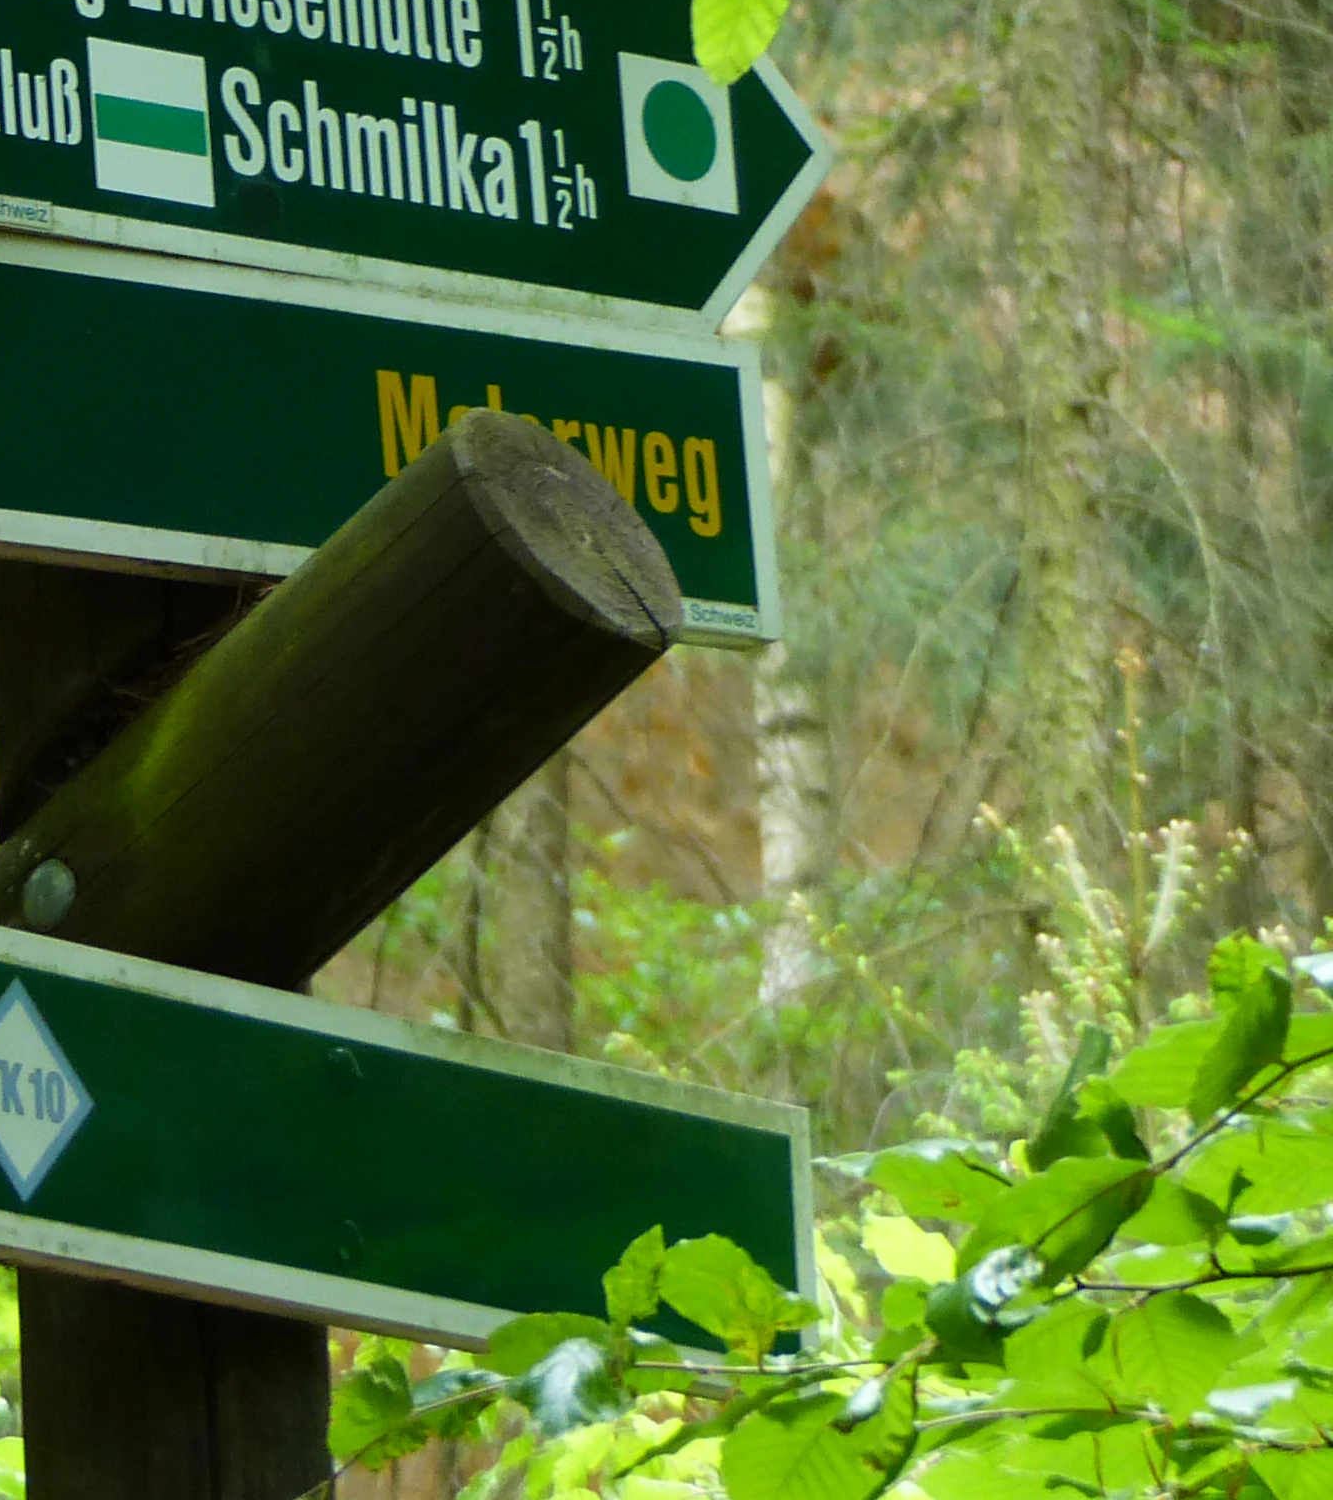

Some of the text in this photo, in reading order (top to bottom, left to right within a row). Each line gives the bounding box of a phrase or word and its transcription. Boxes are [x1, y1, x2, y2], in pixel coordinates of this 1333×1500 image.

[375, 369, 722, 538] Mweg
[689, 603, 755, 629] Schweiz
[28, 1068, 67, 1124] 10
